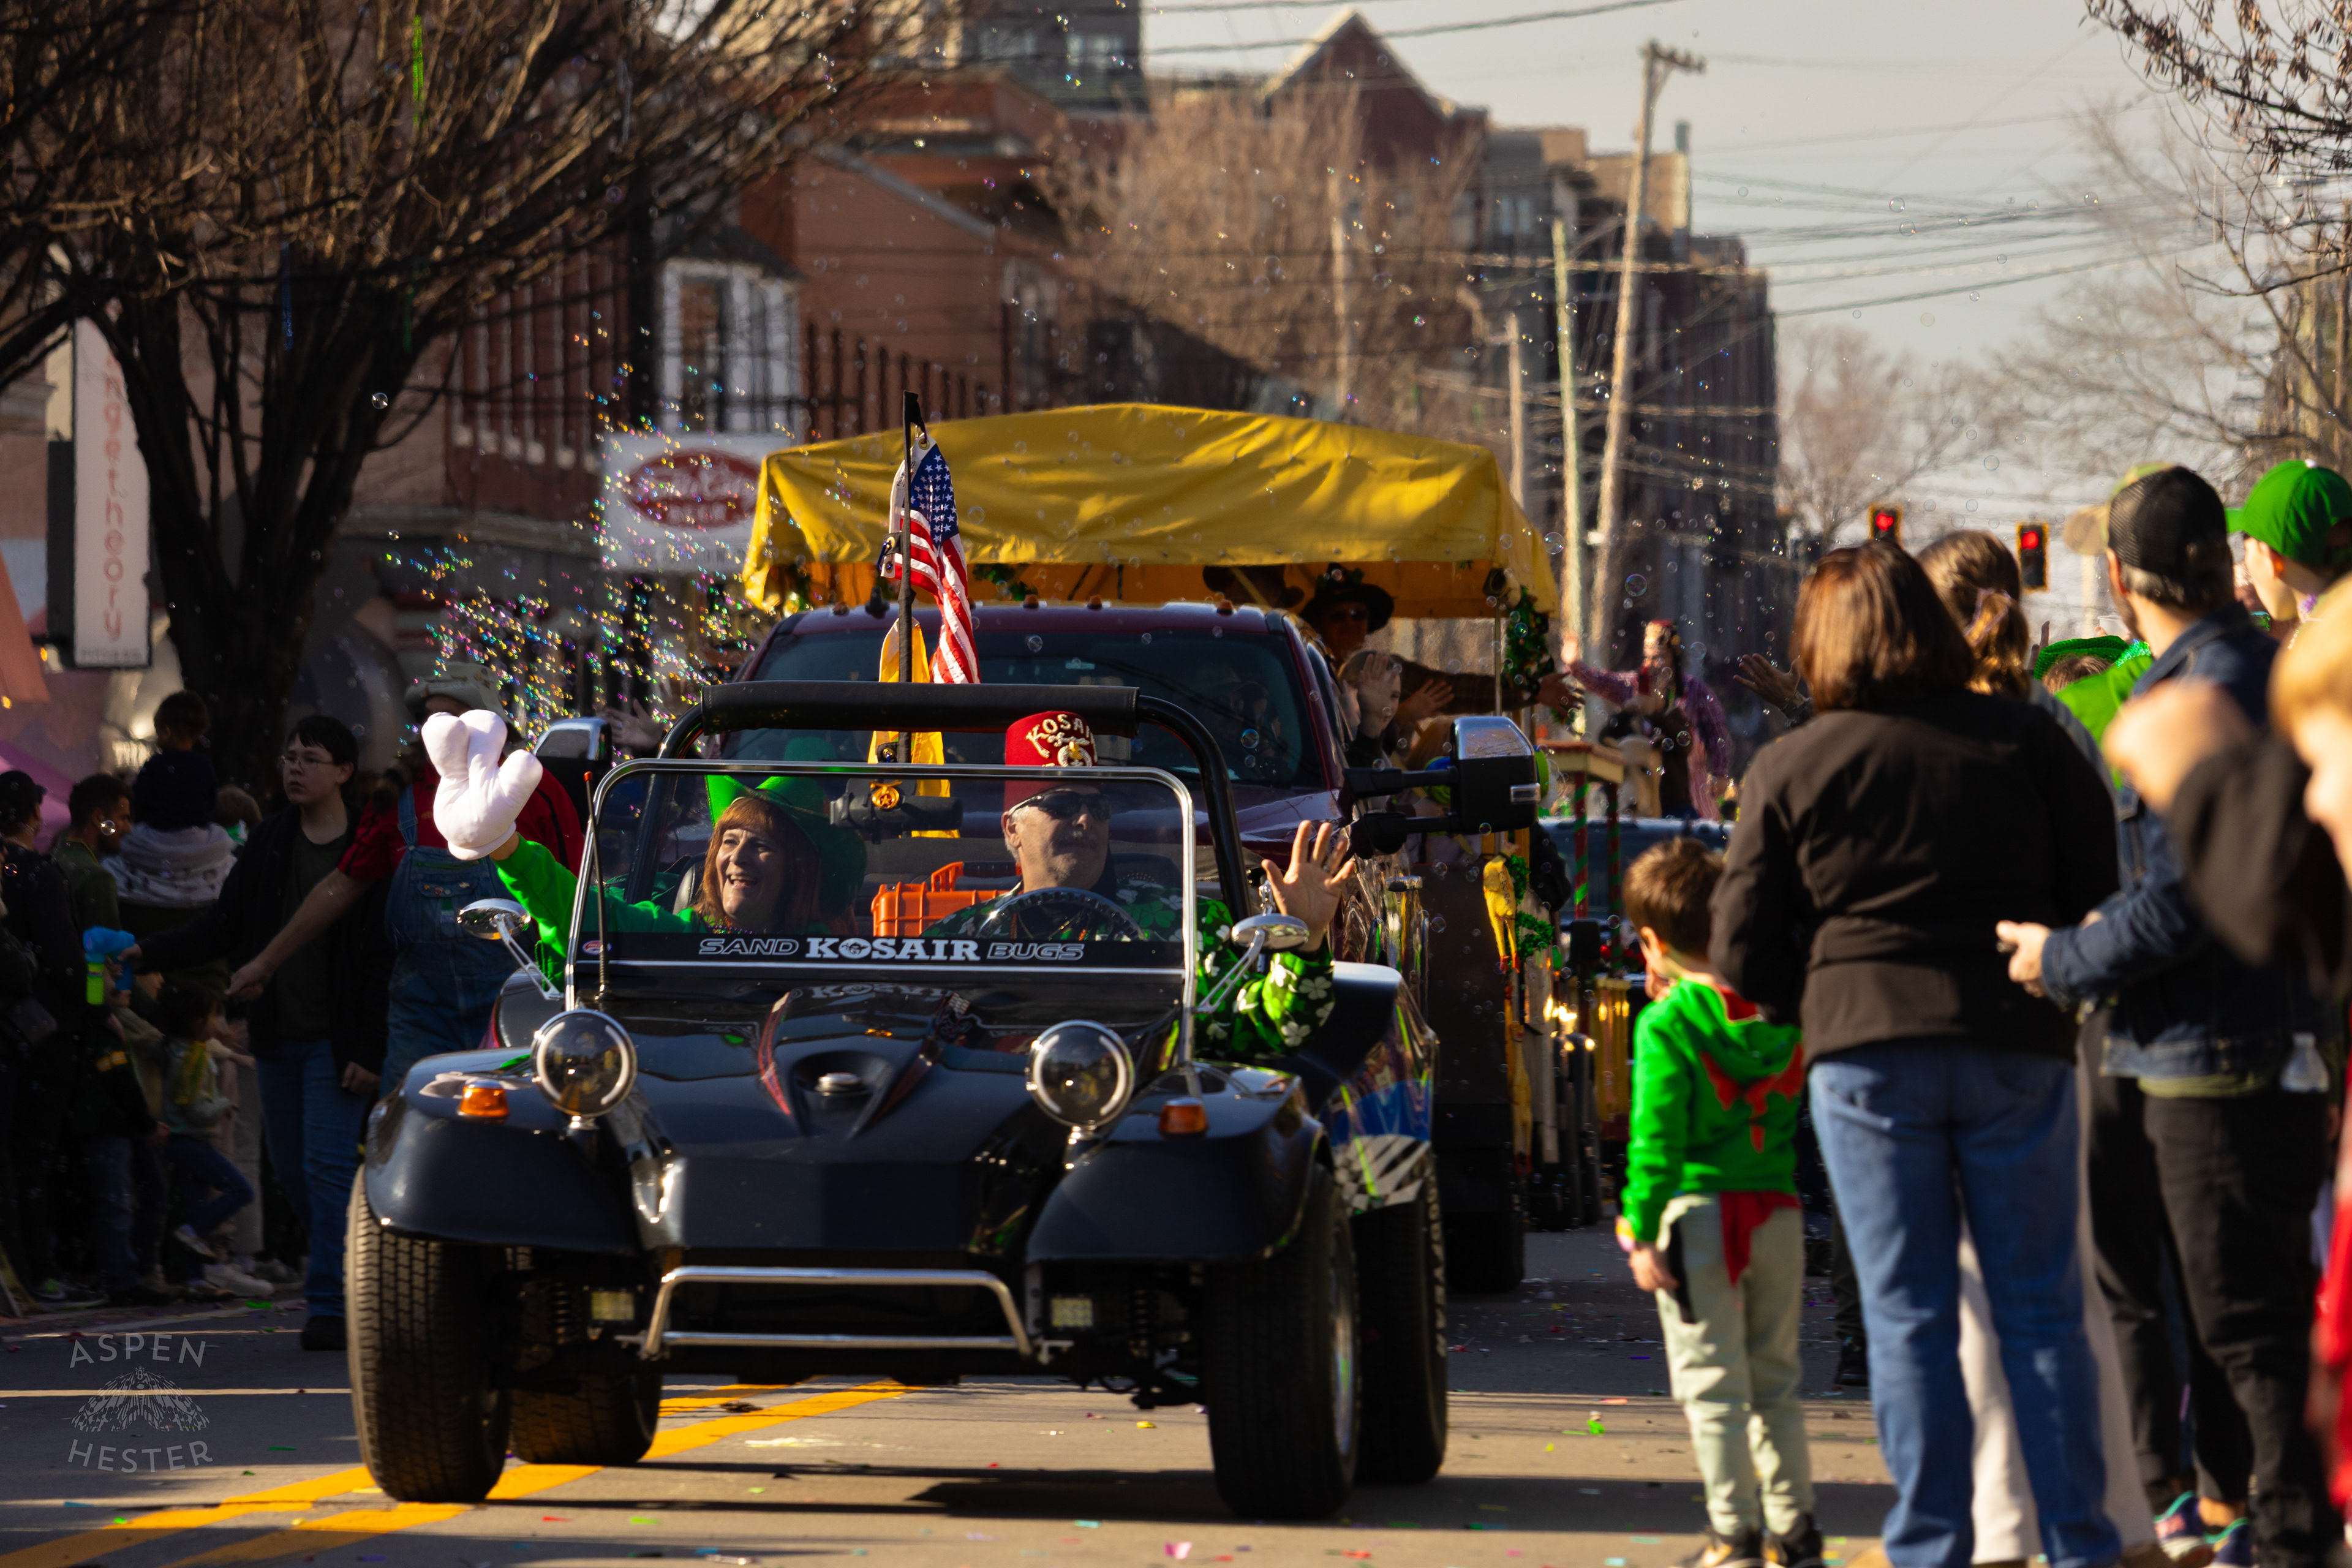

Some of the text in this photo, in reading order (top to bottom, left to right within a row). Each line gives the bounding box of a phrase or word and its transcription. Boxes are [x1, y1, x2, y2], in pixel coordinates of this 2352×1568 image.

[699, 938, 1085, 960] SAND KOSAIR BUGS
